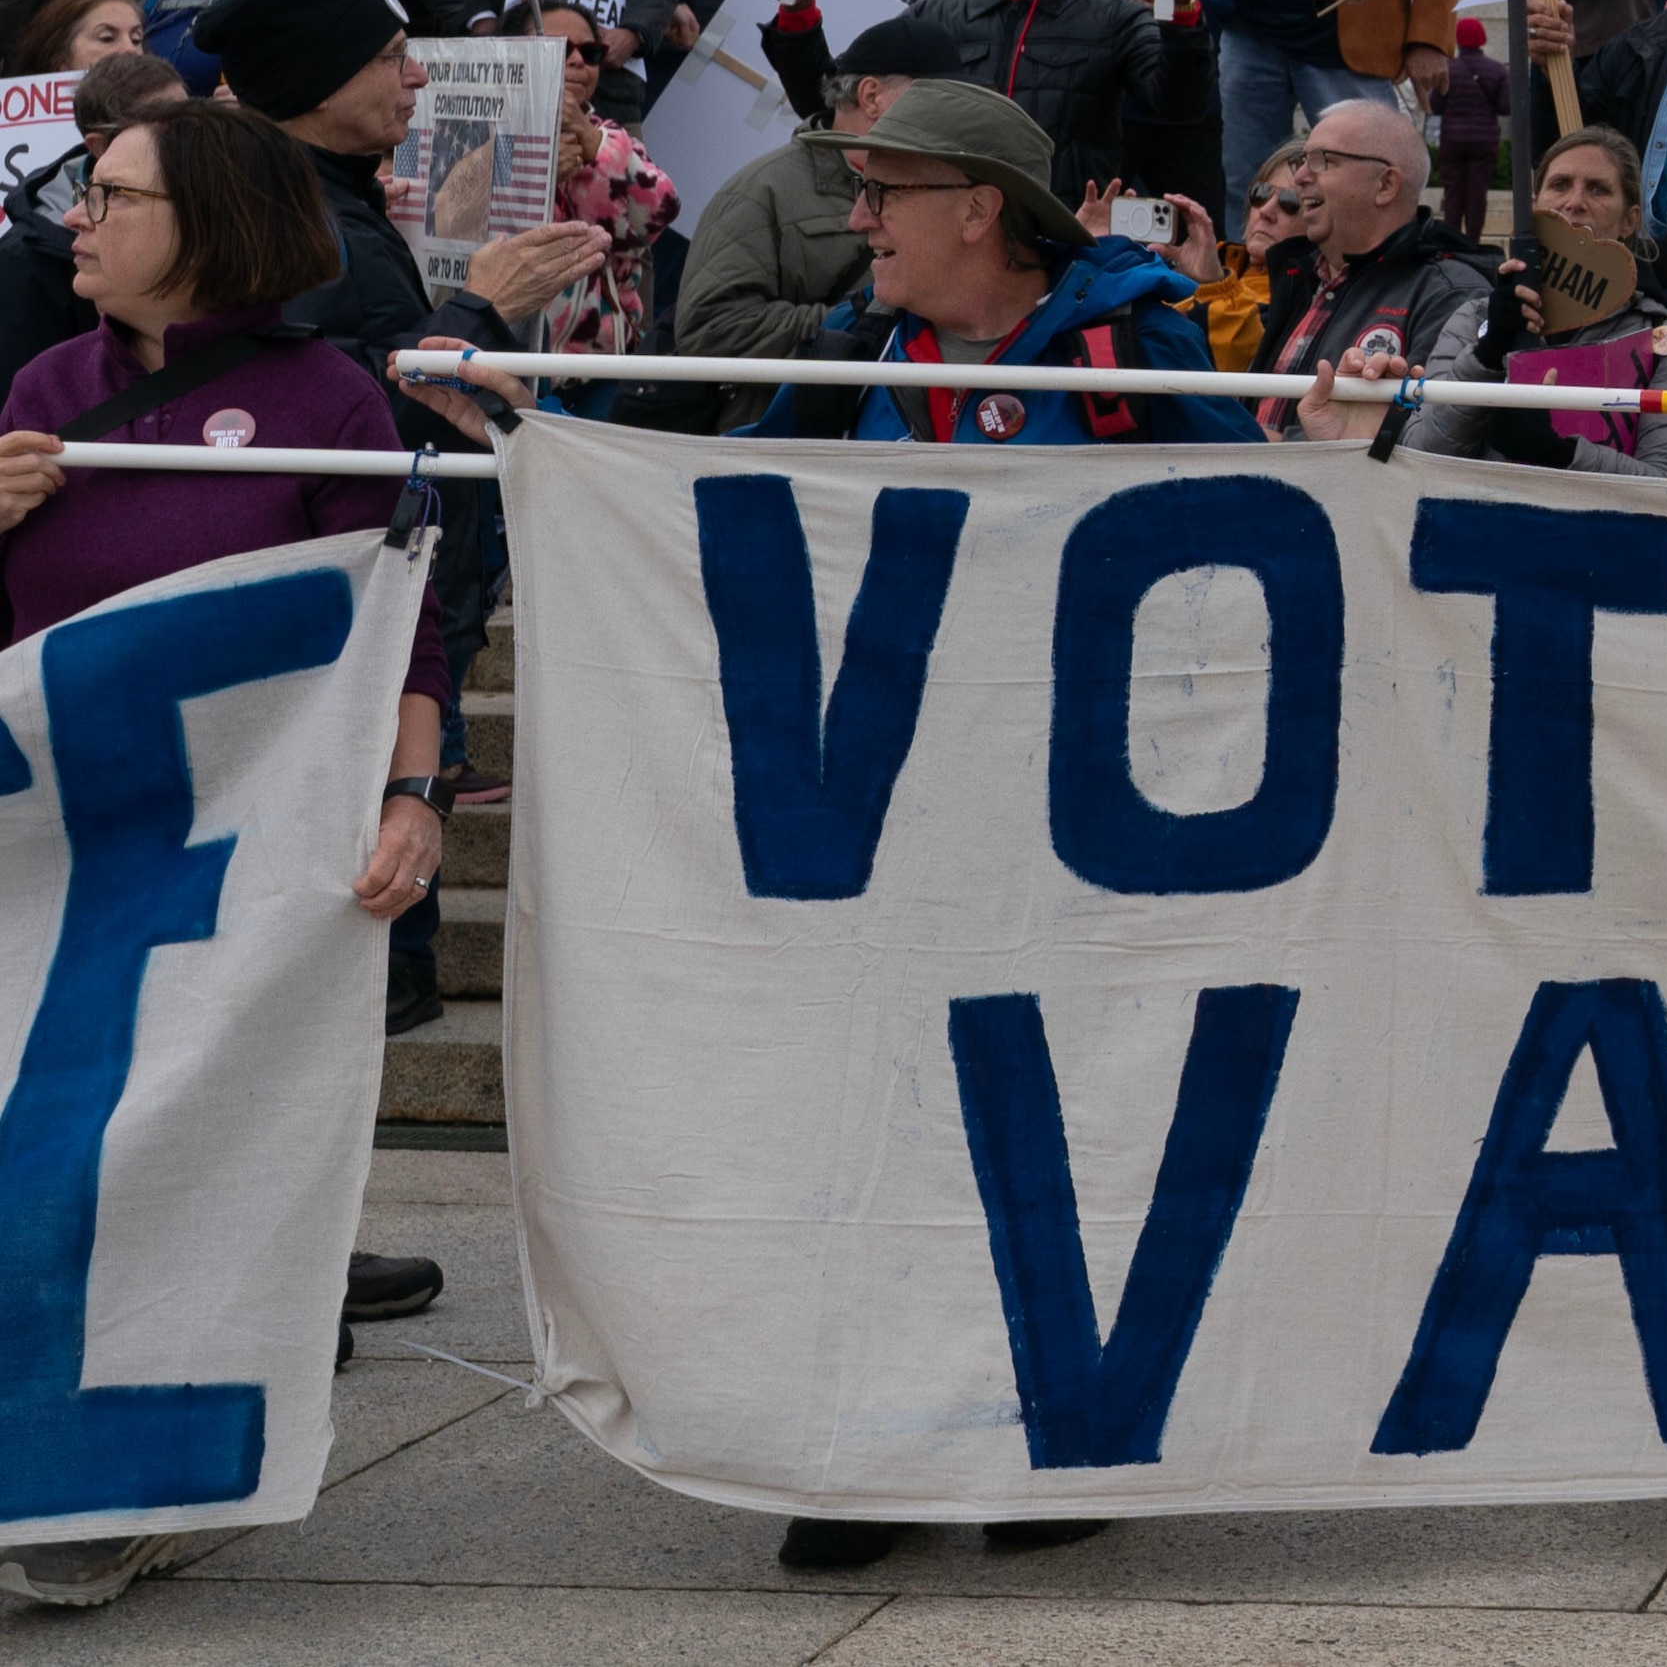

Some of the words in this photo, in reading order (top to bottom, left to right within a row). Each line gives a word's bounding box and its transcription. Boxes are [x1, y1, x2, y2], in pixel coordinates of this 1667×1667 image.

[452, 62, 490, 84] LOYALTY
[506, 63, 525, 85] THE
[0, 79, 76, 122] ONE
[434, 94, 505, 119] CONSTITUTION?
[427, 255, 441, 277] OR
[441, 258, 451, 280] TO
